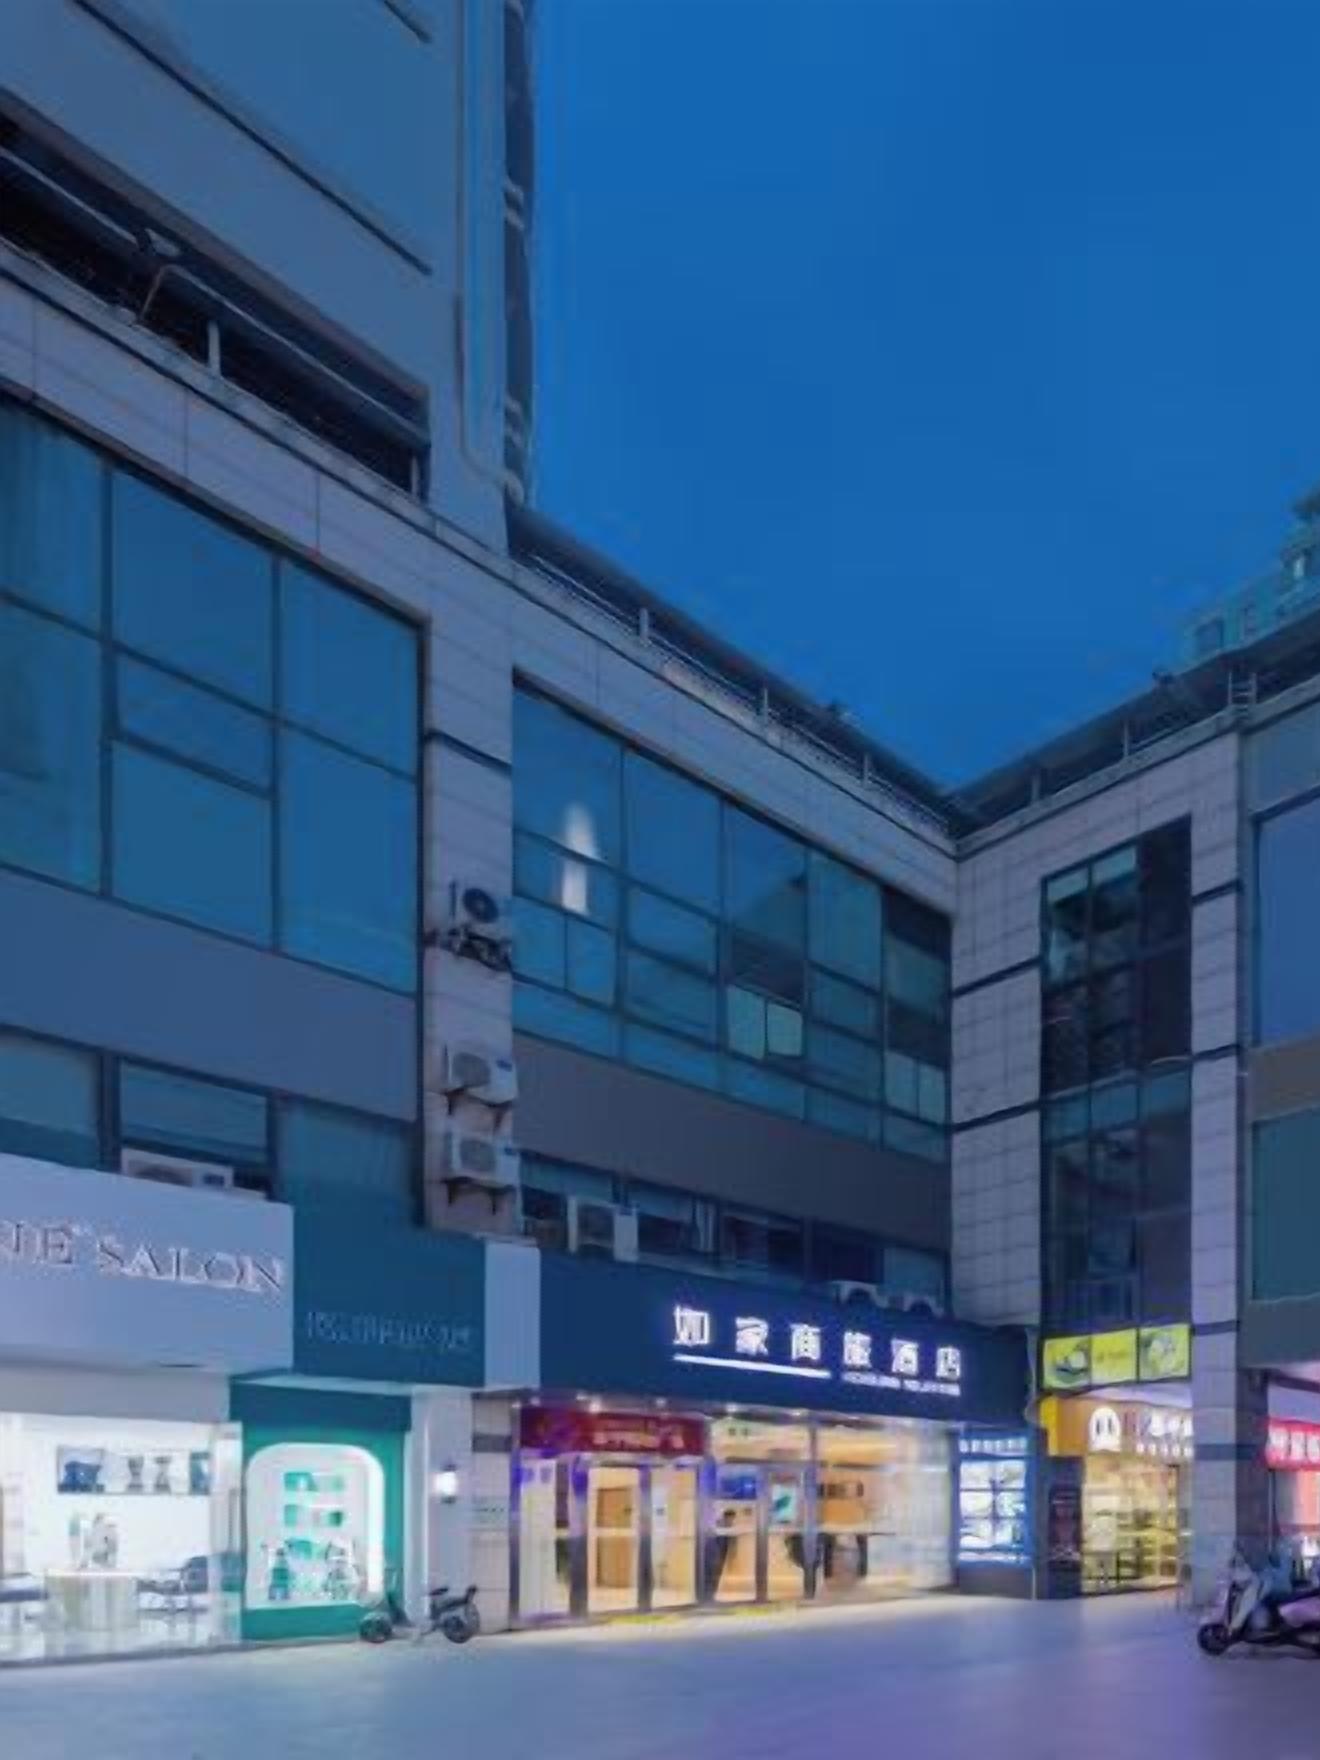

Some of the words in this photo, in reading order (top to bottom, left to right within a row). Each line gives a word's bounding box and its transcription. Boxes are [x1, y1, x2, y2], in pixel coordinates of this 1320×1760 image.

[96, 1236, 283, 1294] SALON
[673, 1304, 961, 1380] 如家商旅酒店
